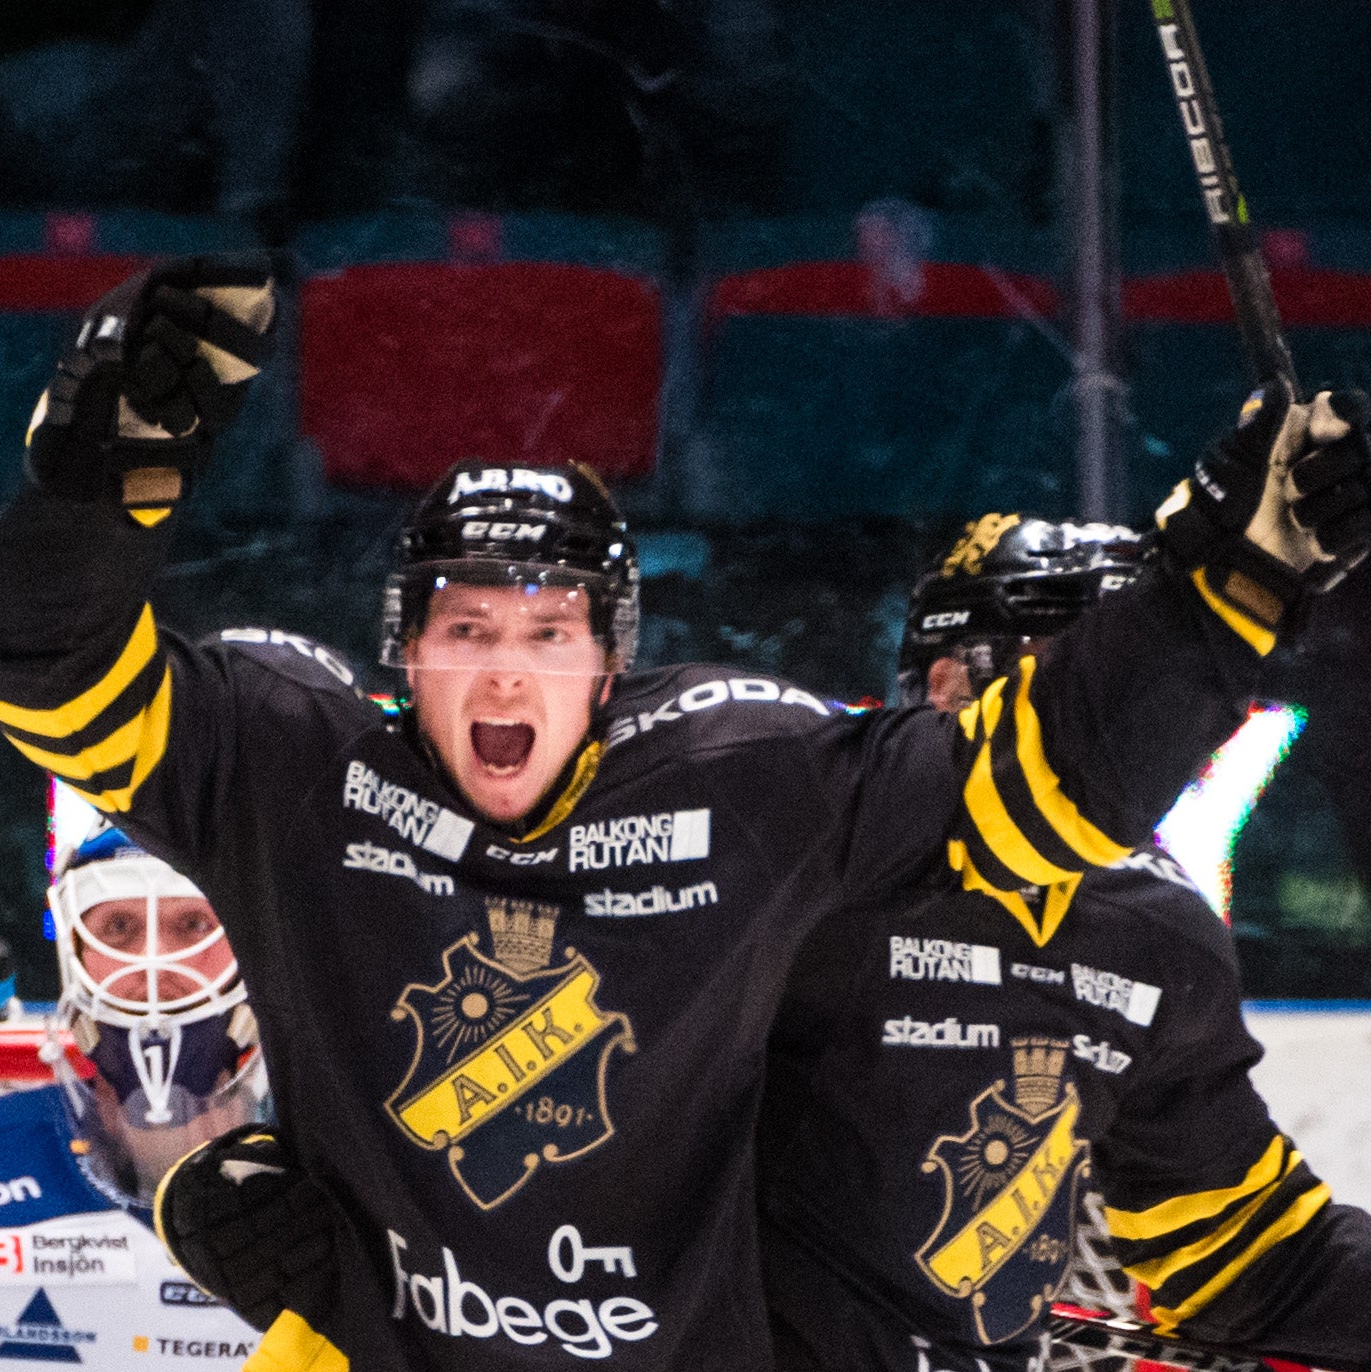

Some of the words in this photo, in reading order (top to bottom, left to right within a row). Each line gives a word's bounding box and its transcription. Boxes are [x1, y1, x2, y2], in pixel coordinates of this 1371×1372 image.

[461, 521, 547, 541] CCM
[922, 611, 971, 630] CCM
[347, 760, 441, 825] BALKONG
[343, 781, 430, 847] RUTAN
[569, 813, 673, 847] BALKONG
[485, 844, 560, 865] CCM
[569, 837, 671, 872] RUTAN
[584, 881, 718, 917] stadium
[890, 953, 973, 982] RUTAN
[882, 1015, 1000, 1048] stadium
[33, 1254, 105, 1278] Insjön
[387, 1228, 659, 1358] Fabege
